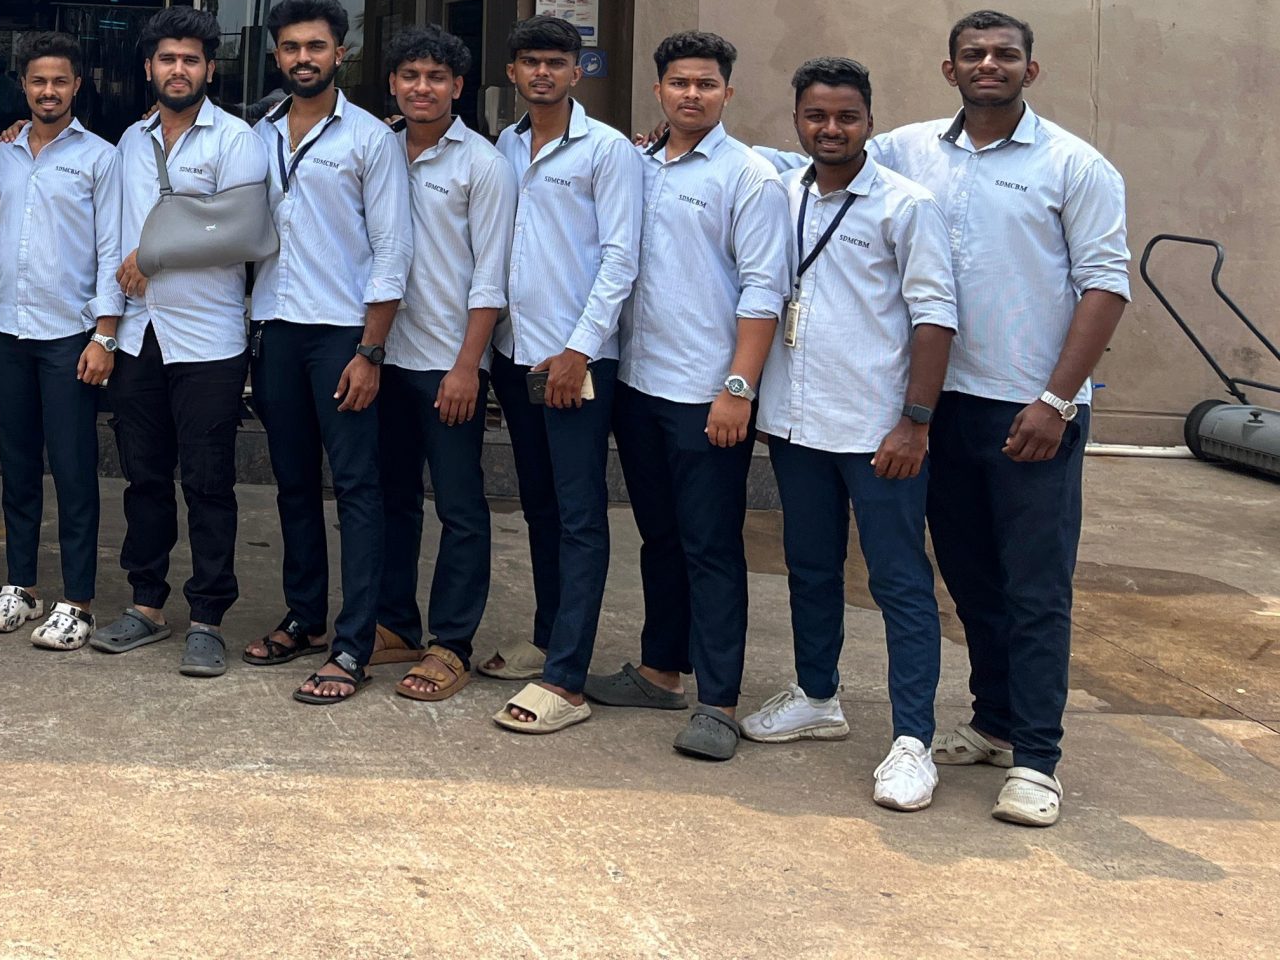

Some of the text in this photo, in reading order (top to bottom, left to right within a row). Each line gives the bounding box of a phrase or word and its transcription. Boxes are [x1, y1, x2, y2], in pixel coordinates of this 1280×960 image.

[313, 157, 340, 169] SDMCBM
[179, 166, 203, 175] SDMCBM
[424, 181, 449, 195] SDMCBM
[544, 175, 571, 188] SDMCBM
[995, 179, 1028, 193] SDMCBM
[679, 194, 707, 208] SDMCBM
[839, 234, 871, 249] SDMCBM
